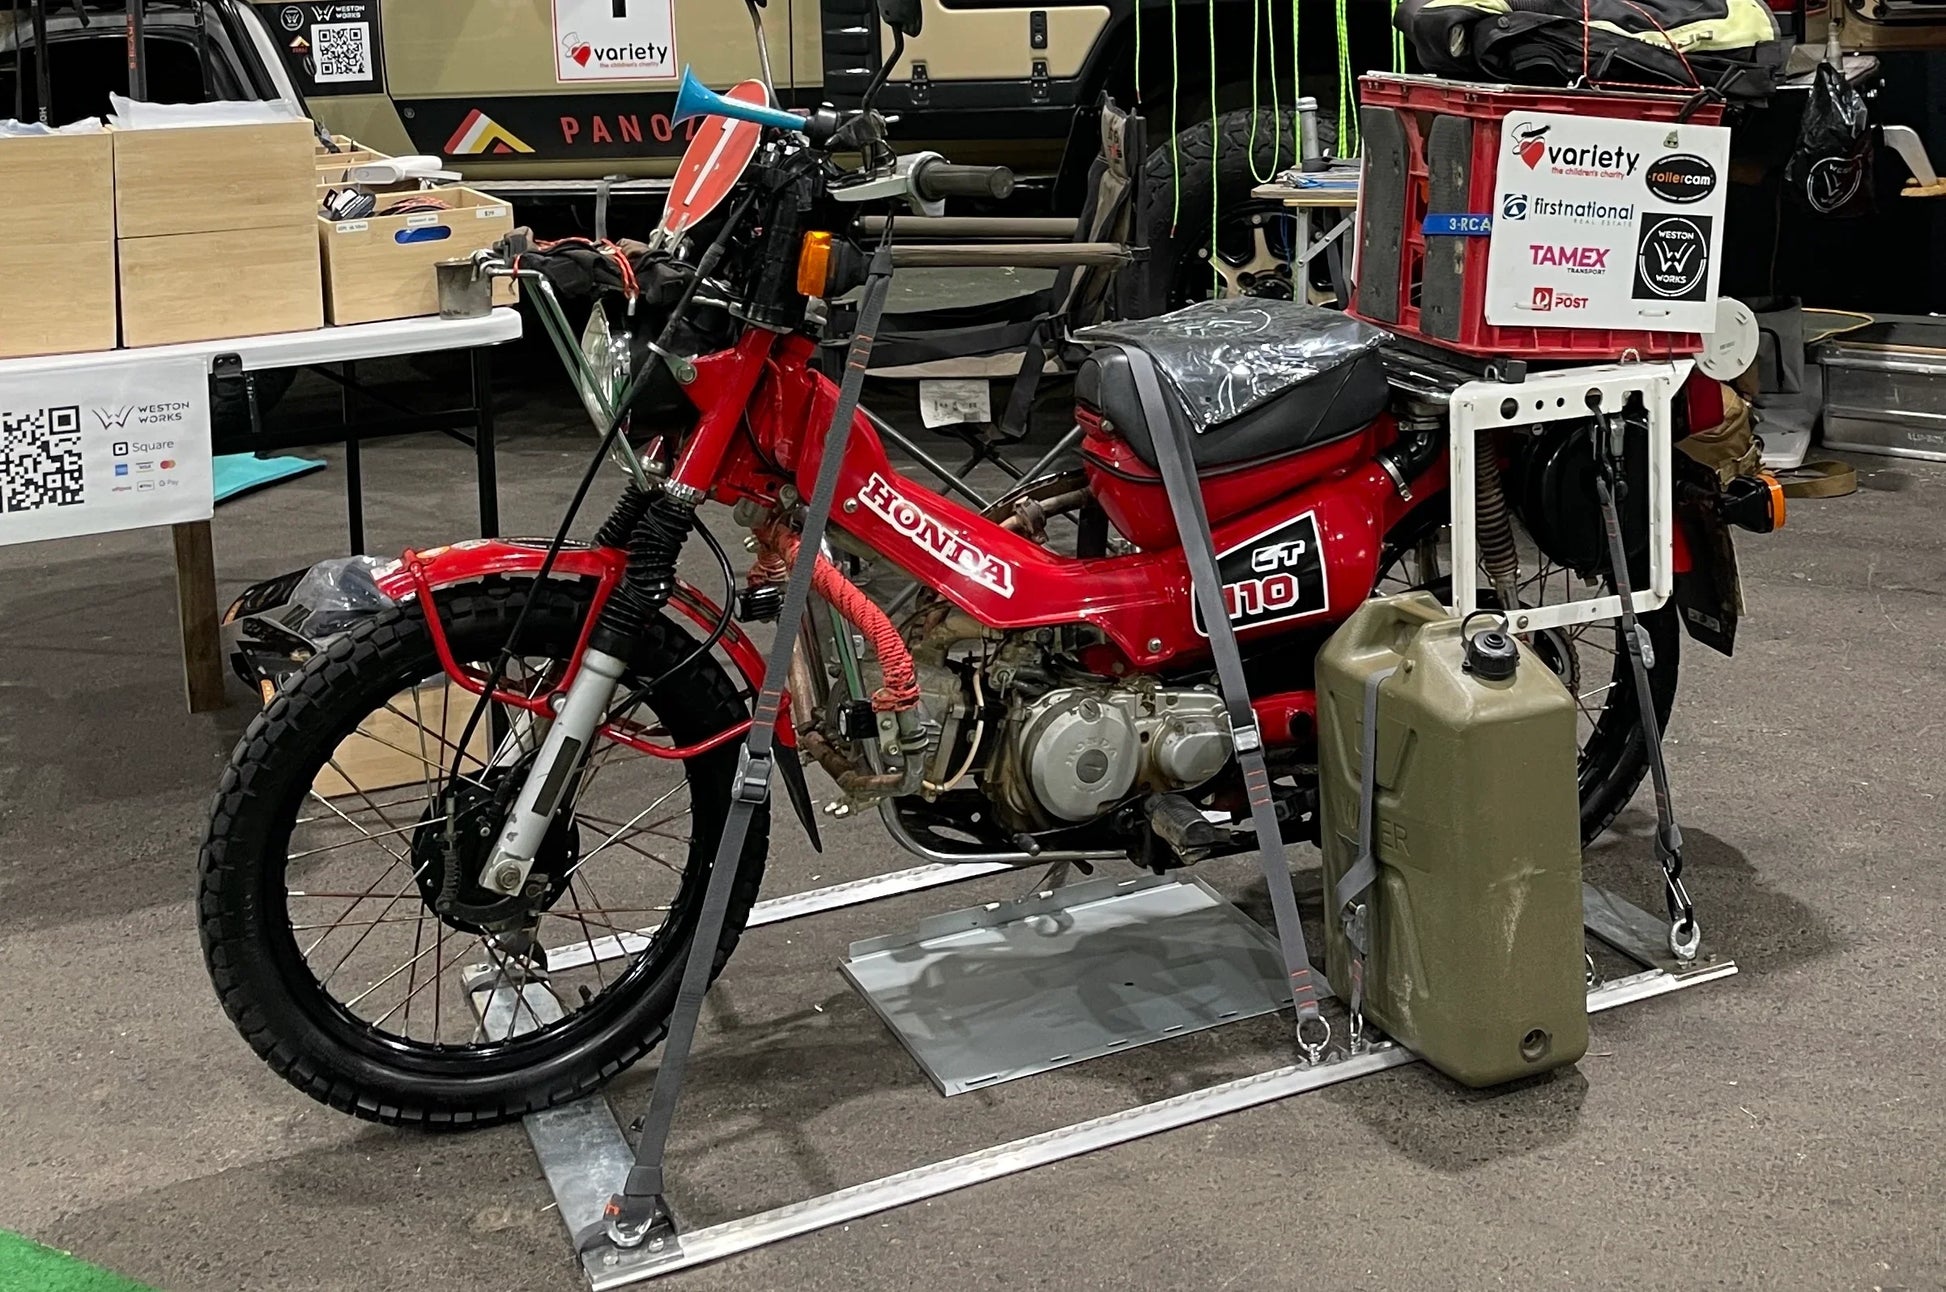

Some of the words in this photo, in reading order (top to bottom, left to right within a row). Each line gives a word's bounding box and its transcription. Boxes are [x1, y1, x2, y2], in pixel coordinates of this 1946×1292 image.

[594, 42, 668, 64] variety
[1548, 144, 1640, 176] variety
[1551, 166, 1564, 175] the
[1565, 167, 1599, 178] children's
[1600, 170, 1626, 180] charity
[1651, 171, 1711, 186] rollercam
[1534, 198, 1634, 220] firstnational
[1573, 218, 1595, 226] REAL
[1601, 219, 1632, 227] ESTATE
[1657, 230, 1695, 240] WESTON
[1529, 244, 1610, 269] TAMEX
[1566, 267, 1606, 275] TRANSPORT
[1655, 274, 1687, 284] WORKS
[1555, 296, 1588, 309] POST
[138, 401, 190, 413] WESTON
[138, 413, 182, 424] WORKS
[132, 441, 174, 453] Square
[861, 474, 1012, 596] HONDA
[1252, 540, 1305, 572] CT
